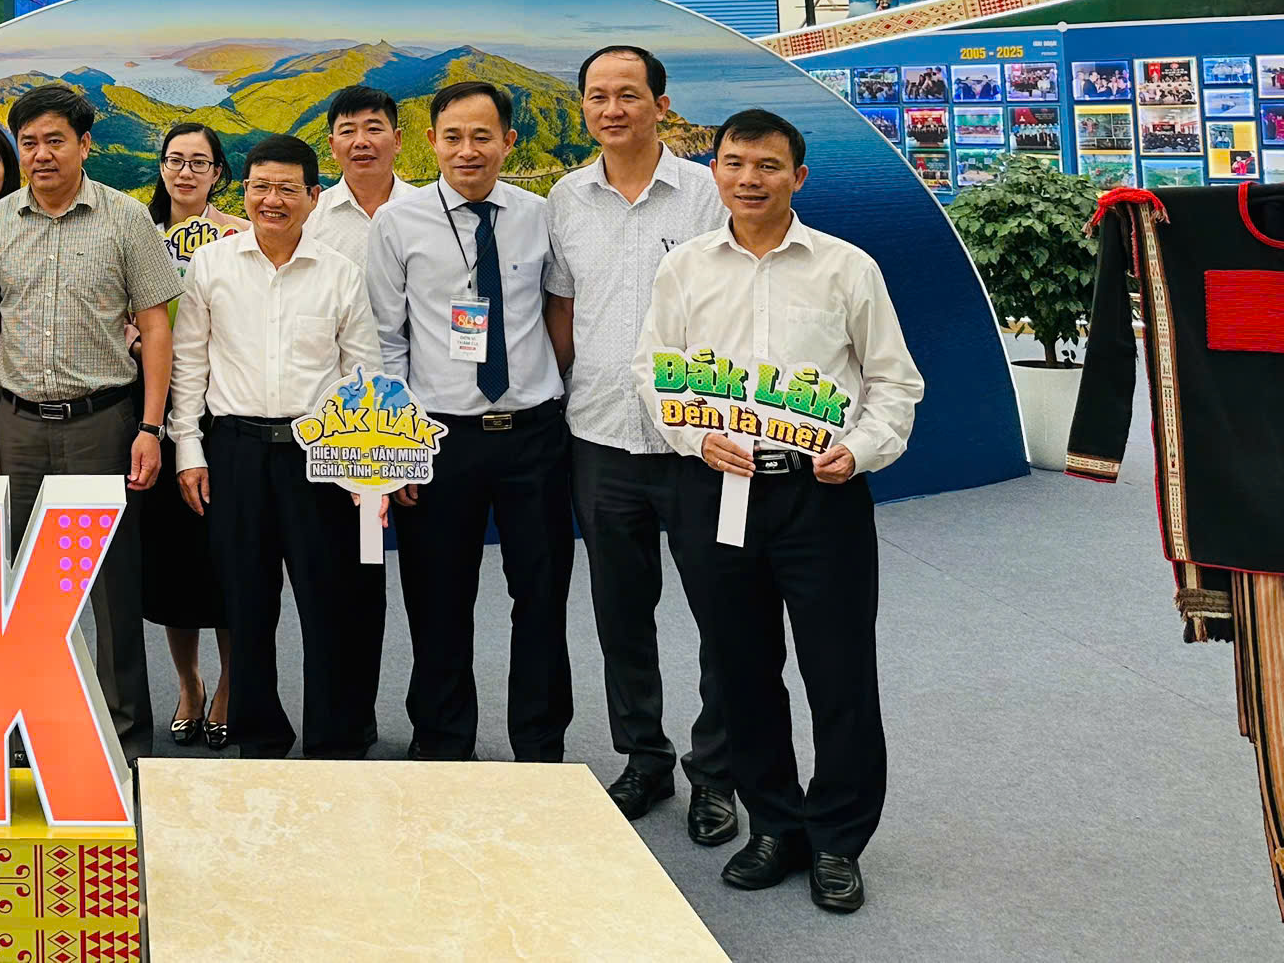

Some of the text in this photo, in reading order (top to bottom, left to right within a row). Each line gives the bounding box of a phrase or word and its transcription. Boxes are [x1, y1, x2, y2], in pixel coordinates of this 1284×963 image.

[960, 47, 986, 59] 2005
[996, 45, 1023, 58] 2025
[652, 348, 851, 429] Đắk Lắk
[296, 400, 445, 450] ĐẮK LẮK
[661, 397, 832, 455] Đến là mê!
[311, 444, 339, 462] HIỆN
[371, 445, 396, 462] VĂN
[397, 448, 429, 462] MINH
[311, 461, 345, 477] NGHĨA
[347, 460, 372, 478] TÌNH
